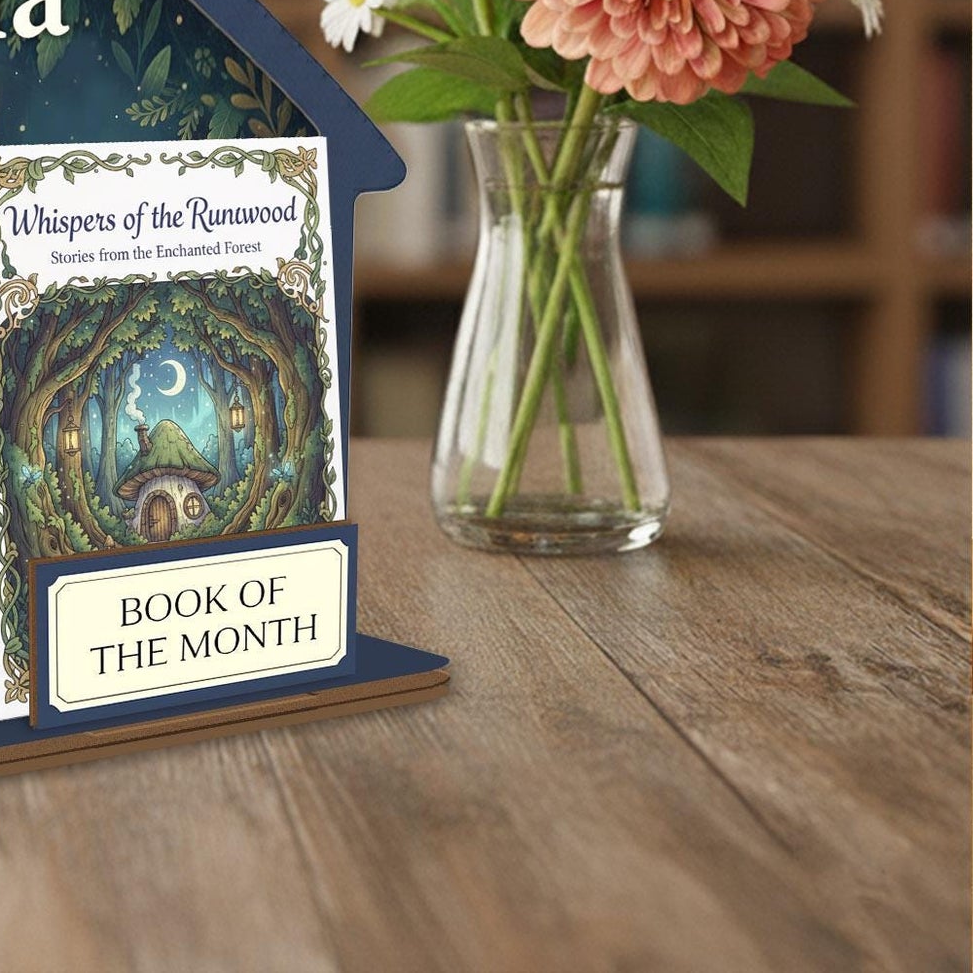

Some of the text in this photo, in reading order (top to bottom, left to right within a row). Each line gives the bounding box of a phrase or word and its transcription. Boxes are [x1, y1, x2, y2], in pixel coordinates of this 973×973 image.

[3, 204, 116, 242] Whispers
[123, 201, 149, 240] of
[152, 202, 185, 229] the
[50, 240, 262, 265] Stories from the Enchanted Forest
[120, 575, 287, 627] BOOK OF
[90, 613, 317, 675] THE MONTH
